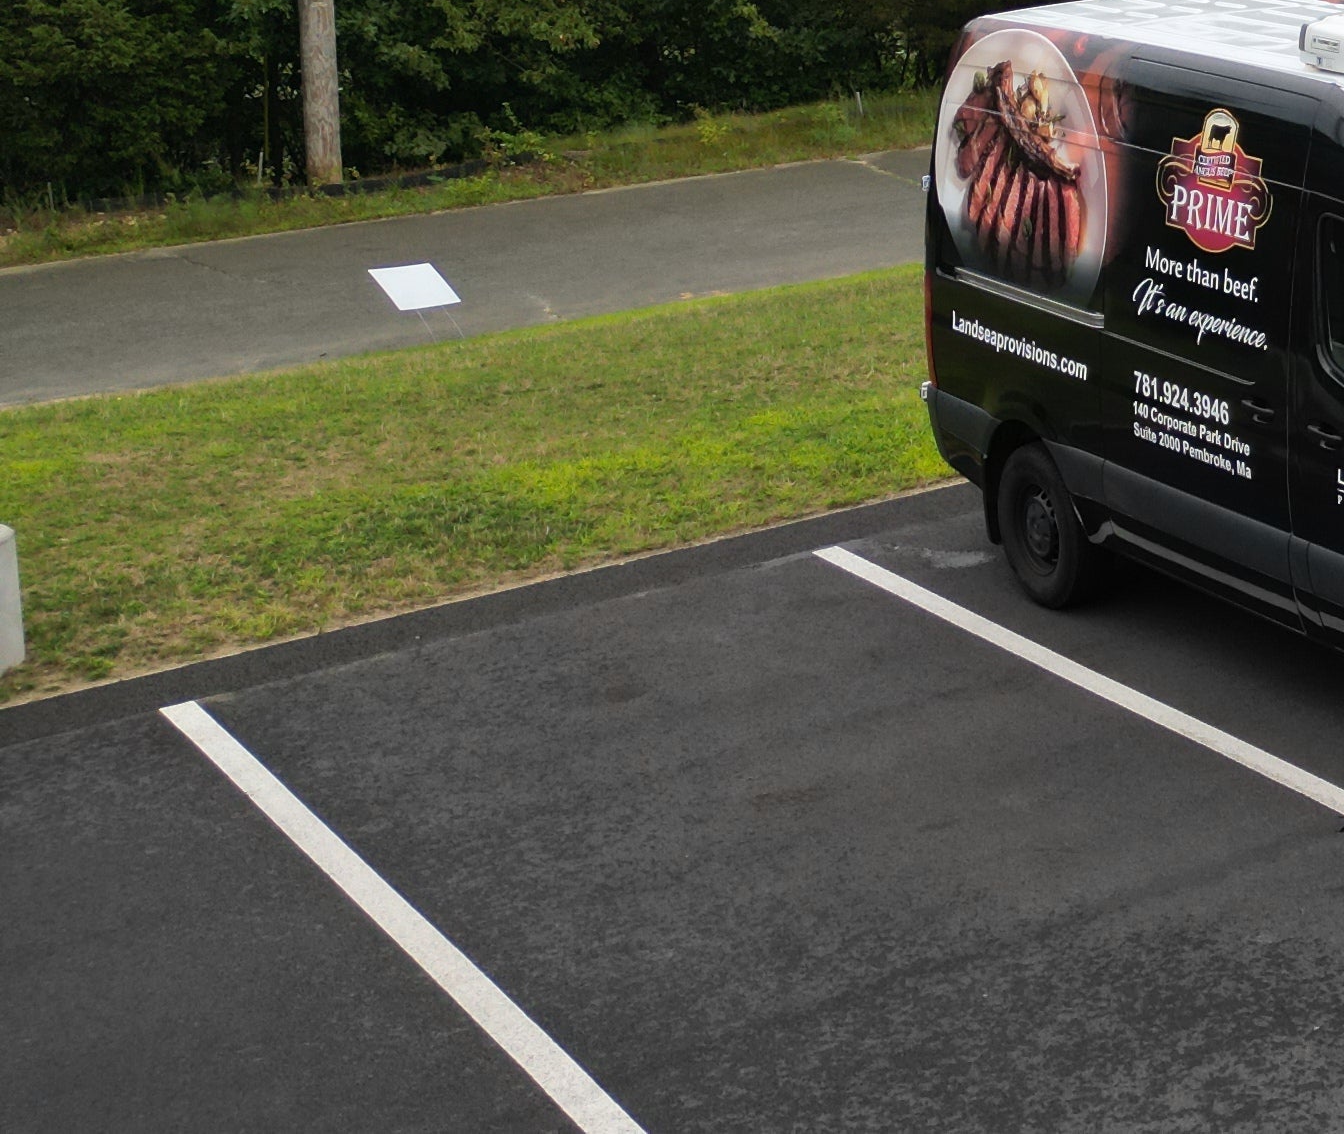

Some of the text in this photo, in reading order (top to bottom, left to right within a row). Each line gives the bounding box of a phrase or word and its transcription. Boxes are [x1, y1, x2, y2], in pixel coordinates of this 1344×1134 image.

[1170, 184, 1253, 241] PRIME
[1145, 245, 1259, 303] More than beef.
[1132, 278, 1268, 351] It's an experience.
[952, 310, 1088, 381] Landseaprovisions.com
[1133, 370, 1230, 425] 781.924.3946
[1132, 400, 1251, 457] 140 Corporate Park Drive
[1133, 421, 1252, 480] Suite 2000 Pembroke, Ma
